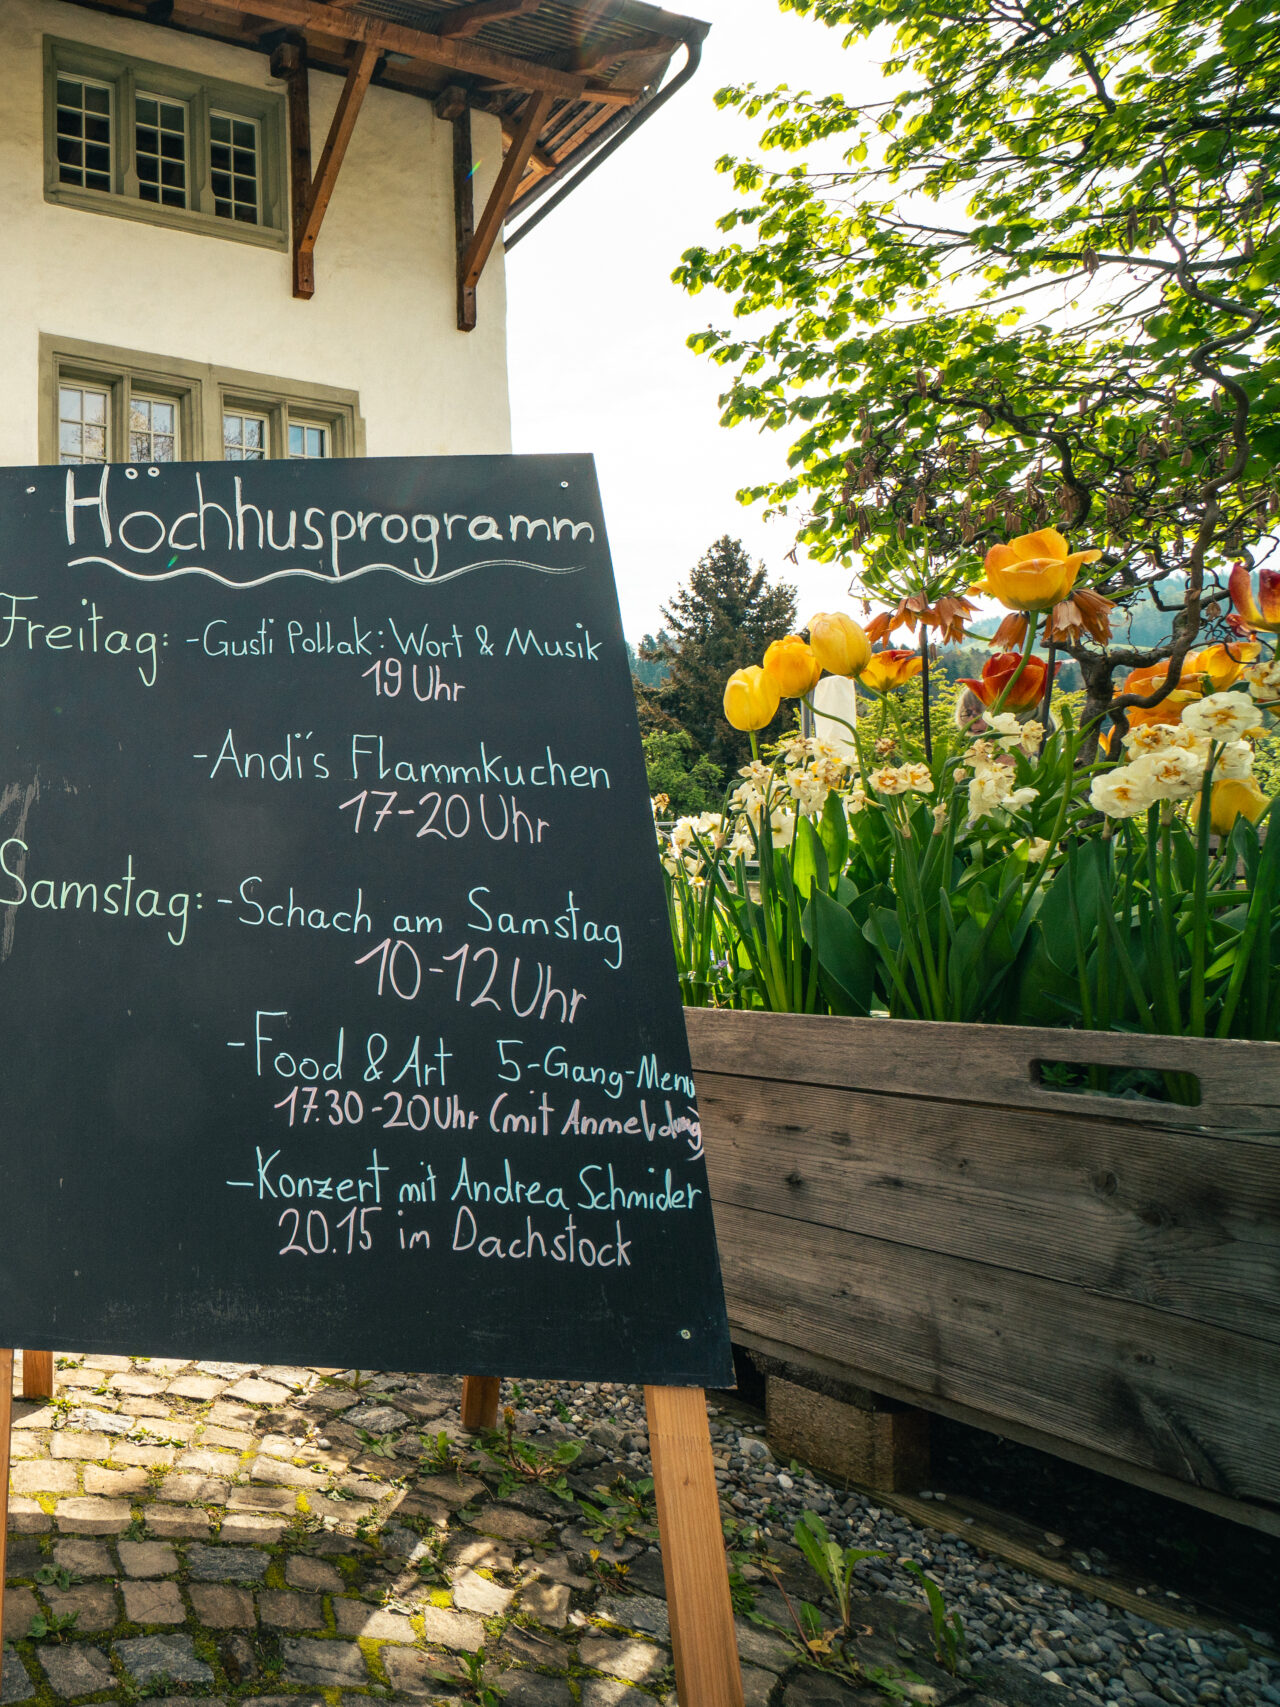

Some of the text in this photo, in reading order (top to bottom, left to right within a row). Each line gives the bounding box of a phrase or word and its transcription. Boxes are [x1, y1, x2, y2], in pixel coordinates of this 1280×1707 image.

[65, 464, 595, 577] Höchhusprogramm
[475, 624, 495, 656] &
[505, 622, 602, 661] Musik
[361, 657, 466, 702] 19 Uhr
[351, 734, 611, 789] Flammkuchen
[339, 790, 550, 844] 17-20 Uhr
[393, 914, 444, 933] am
[468, 886, 623, 970] Samstag
[354, 938, 588, 1024] 10-12 Uhr
[489, 1090, 556, 1137] (mit
[399, 1161, 437, 1204] mit
[451, 1157, 571, 1211] Andrea
[577, 1163, 703, 1213] Schmider
[278, 1206, 383, 1257] 20.15
[452, 1205, 632, 1268] Dachstock
